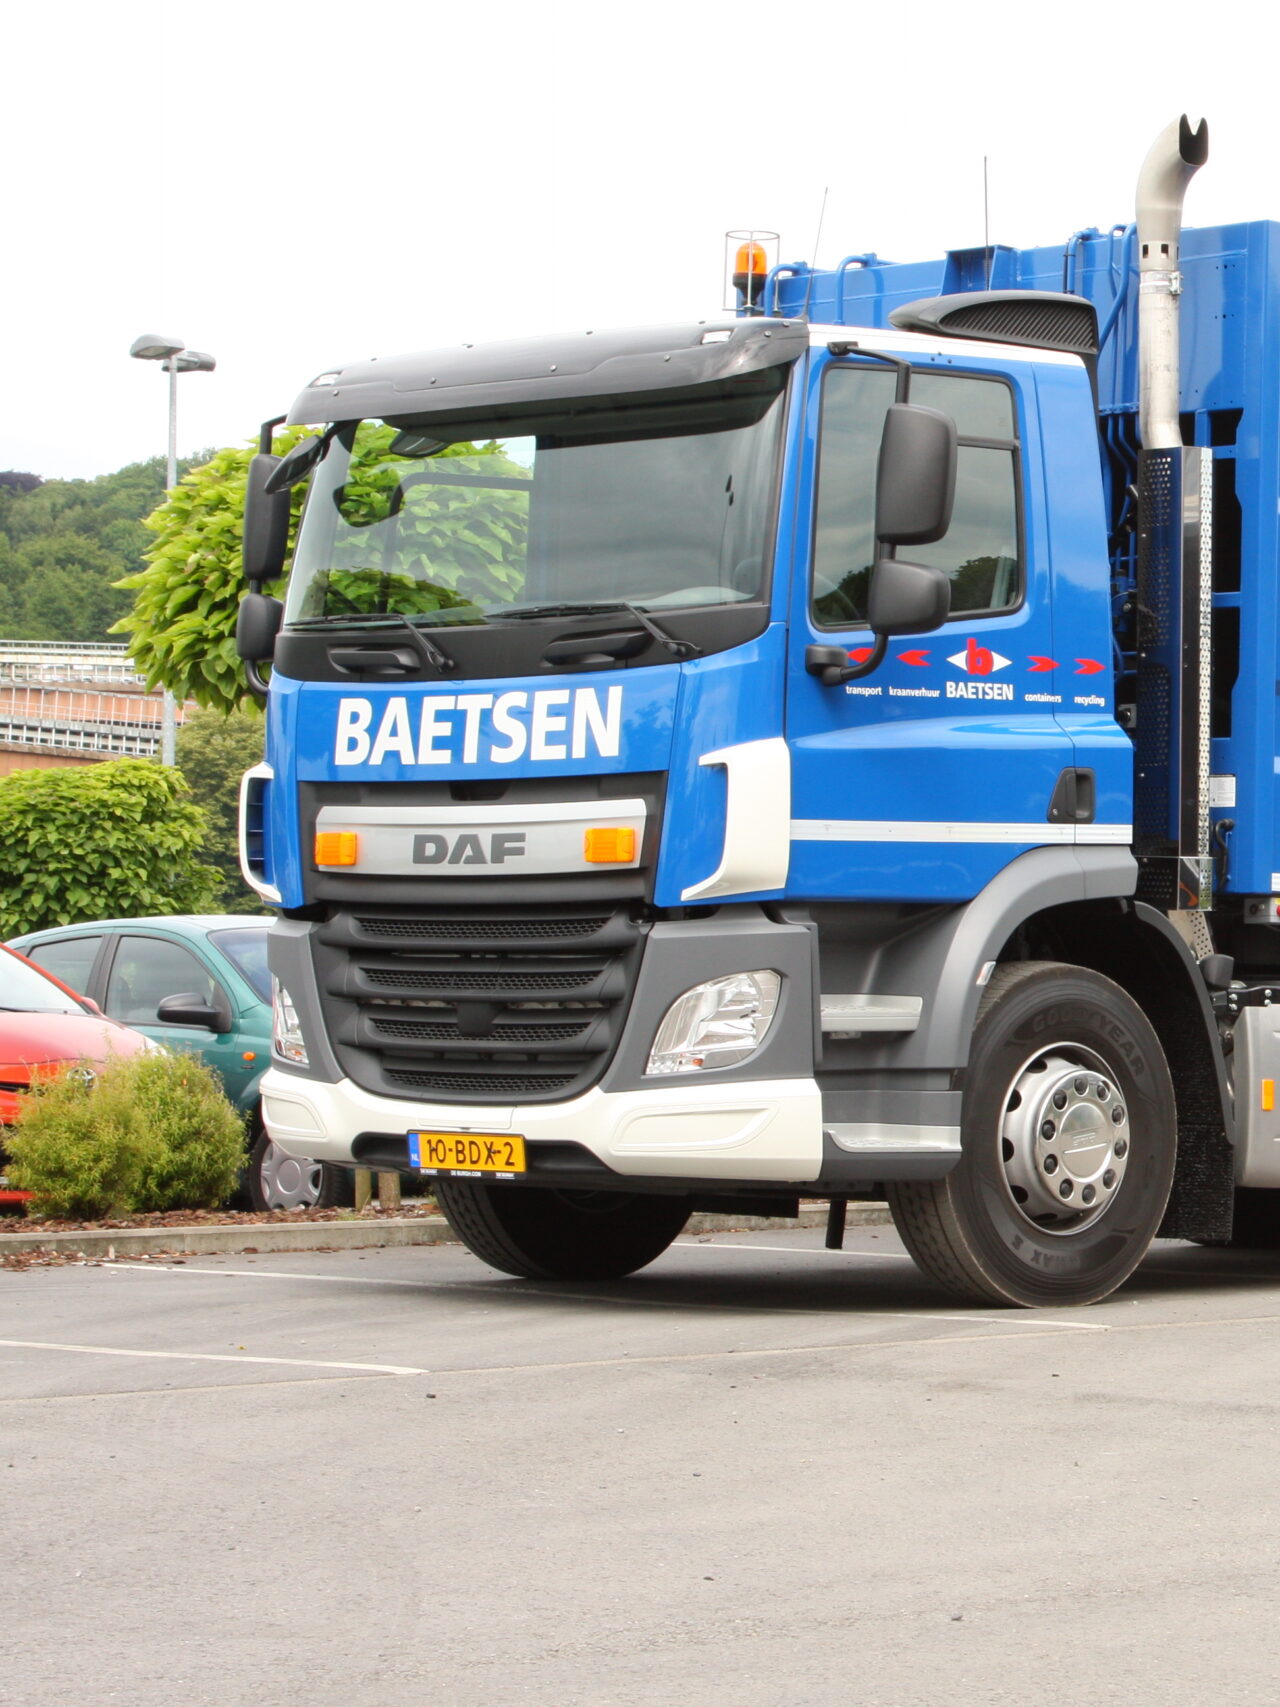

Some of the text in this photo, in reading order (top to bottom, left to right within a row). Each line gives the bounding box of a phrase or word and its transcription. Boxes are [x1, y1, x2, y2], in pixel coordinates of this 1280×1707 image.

[845, 681, 1105, 707] transport kraanverhuur BAETSEN containers recycling
[334, 685, 624, 766] BAETSEN
[412, 832, 527, 865] DAF
[426, 1138, 516, 1167] 10-BDX-2
